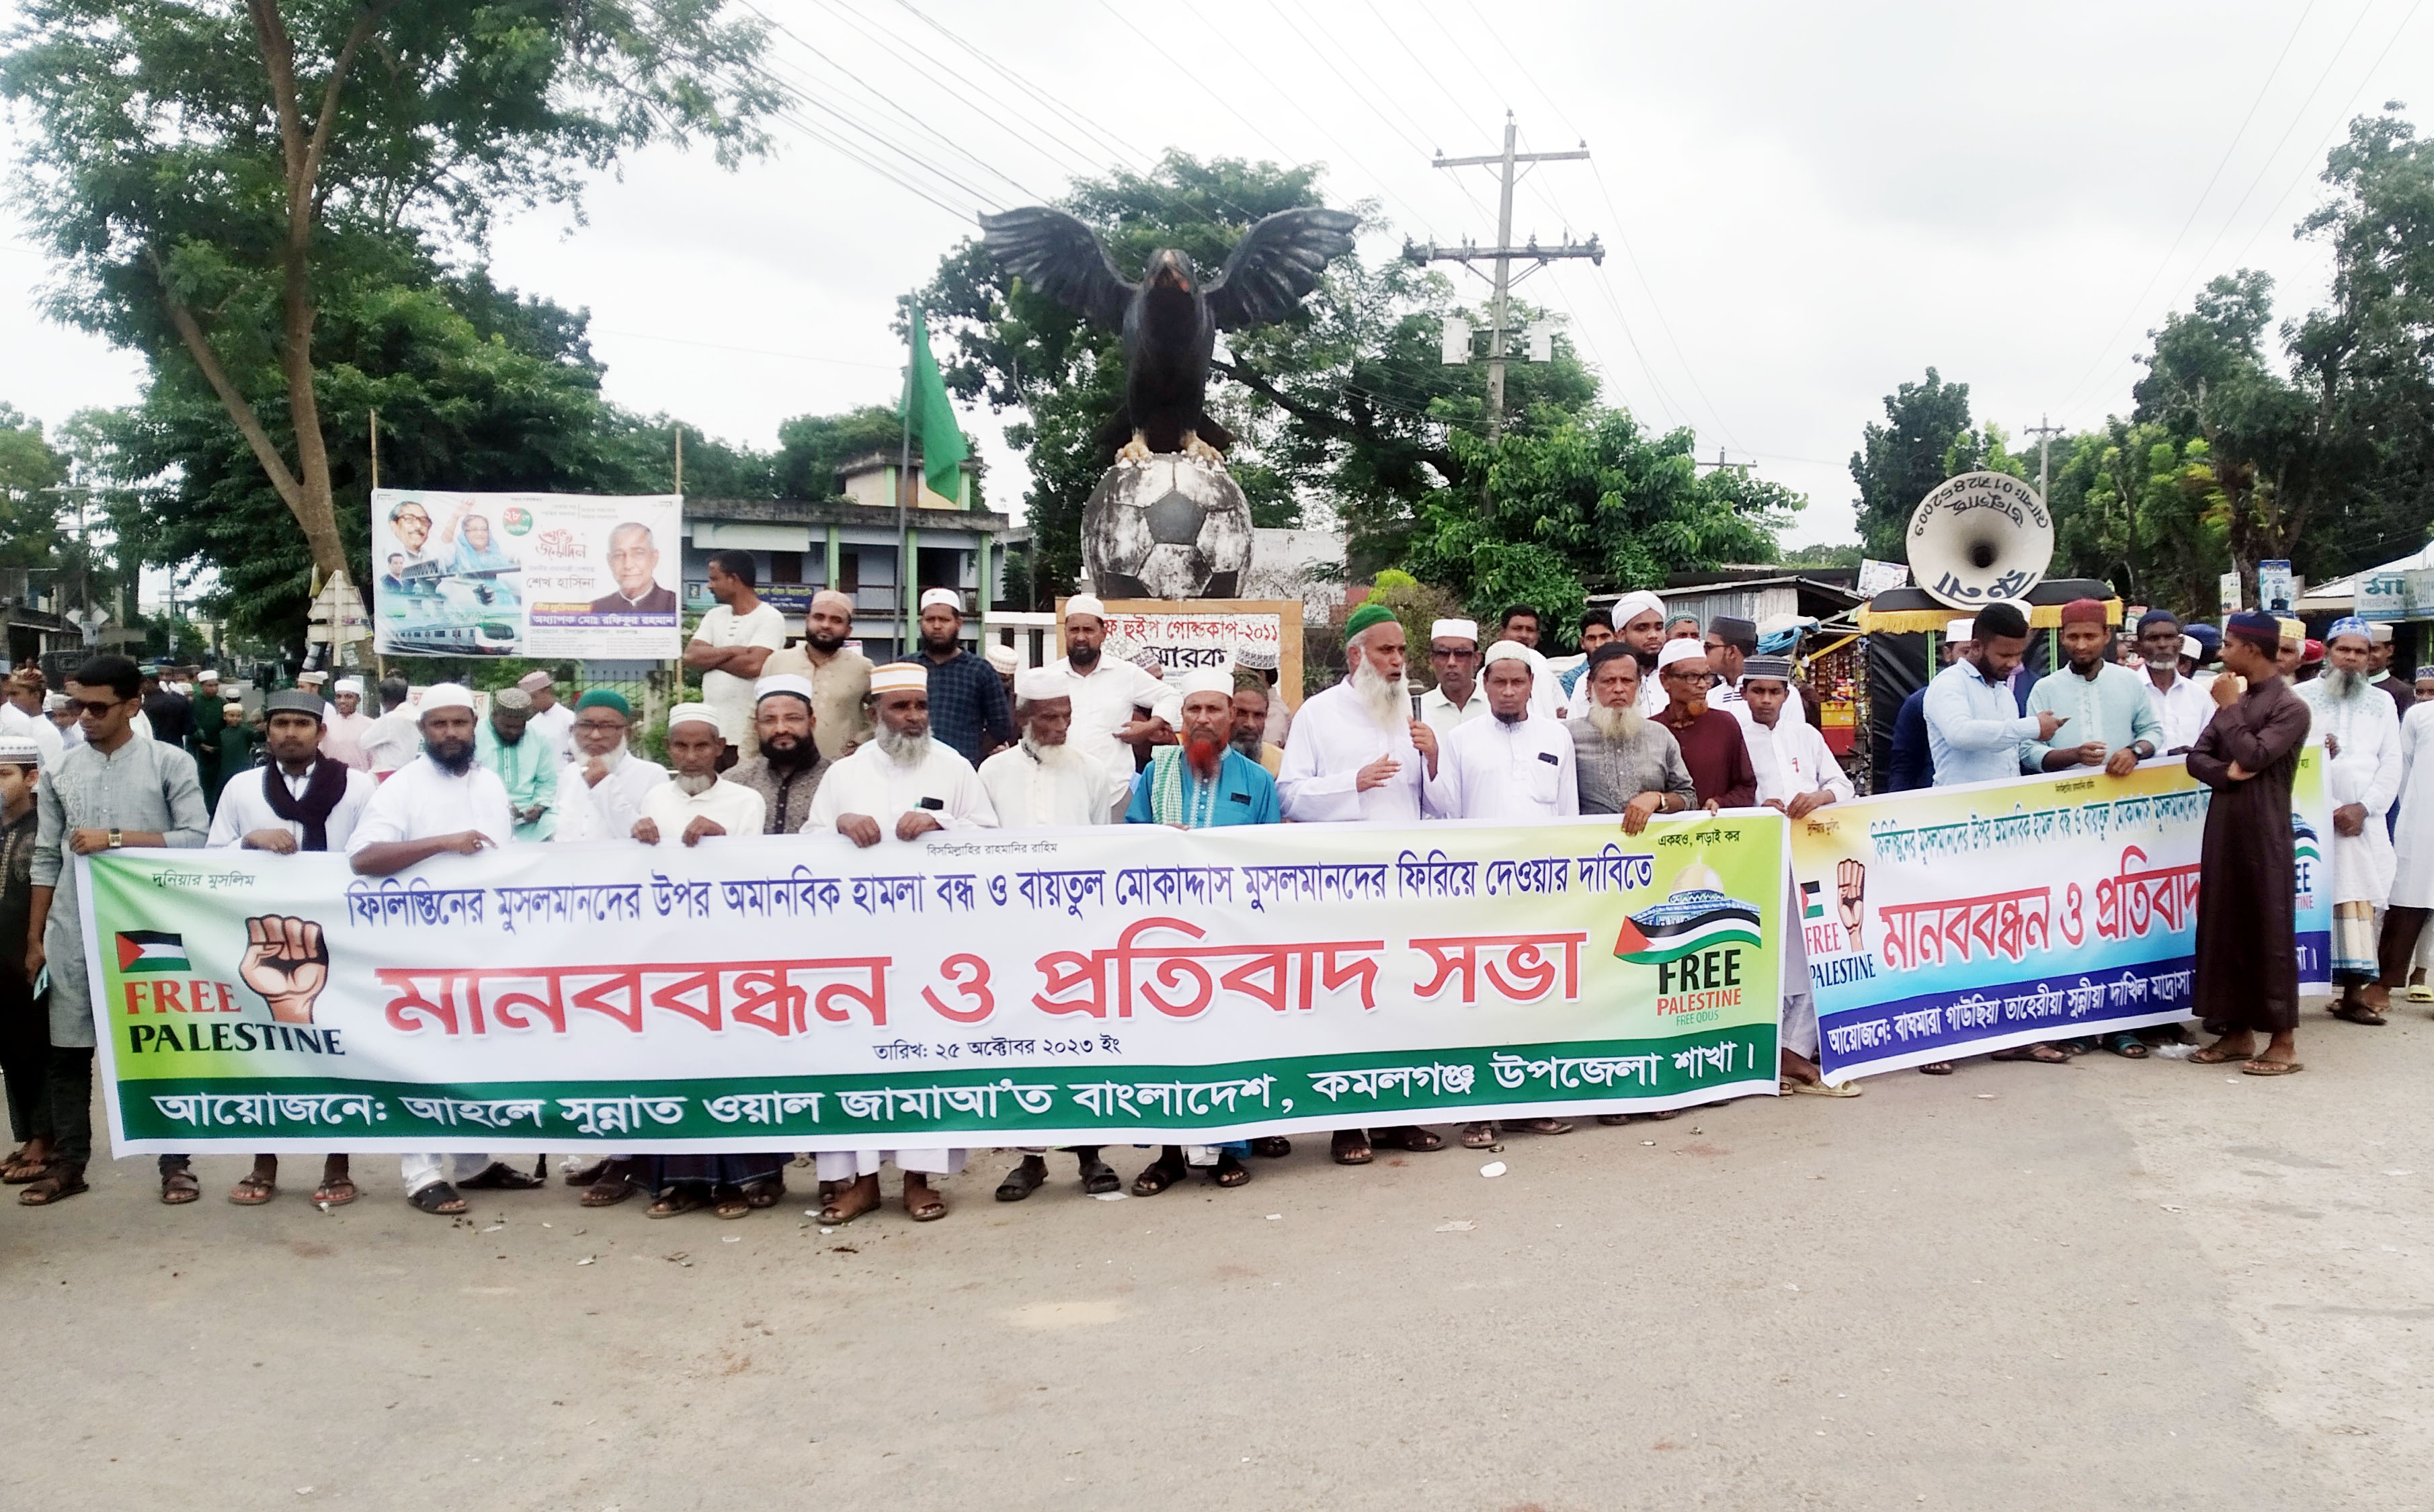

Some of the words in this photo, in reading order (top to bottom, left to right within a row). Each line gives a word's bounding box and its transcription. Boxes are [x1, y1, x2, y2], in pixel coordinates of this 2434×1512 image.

[526, 577, 551, 589] শেখ
[557, 573, 596, 589] হাসিনা
[1031, 841, 1058, 854] রাহিম
[1696, 829, 1722, 845] লড়াই
[1724, 830, 1741, 842] কর
[152, 869, 203, 888] দুনিয়ার
[208, 870, 256, 890] মুসলিম
[344, 876, 485, 927] ফিলিস্তিনের
[493, 882, 643, 935] মুসলমানদের
[649, 869, 712, 919] উপর
[719, 864, 840, 917] অমানবিক
[850, 871, 928, 915] হামলা
[934, 873, 977, 912] বন্ধ
[986, 876, 1008, 906] ও
[1016, 869, 1106, 920] বায়তুল
[1115, 863, 1235, 907] মোকাদ্দাস
[1242, 858, 1389, 911] মুসলমানদের
[1395, 849, 1479, 898] ফিরিয়ে
[1485, 855, 1571, 895] দেওয়ার
[1576, 843, 1656, 892] দাবিতে
[2296, 864, 2312, 892] EE
[1805, 923, 1841, 956] FREE
[1878, 886, 2051, 968] মানববন্ধন
[2060, 882, 2083, 947] ও
[374, 955, 893, 1038] মানববন্ধন
[922, 953, 995, 1025] ও
[1032, 917, 1385, 1019] প্রতিবাদ
[1410, 932, 1587, 1004] সভা
[1659, 949, 1741, 995] FREE
[1810, 954, 1876, 989] PALESTINE
[124, 980, 241, 1014] FREE
[1657, 988, 1742, 1016] PALESTINE
[1893, 1005, 1942, 1042] বাঘমারা
[2109, 971, 2149, 1007] দাখিল
[2151, 969, 2191, 1005] মাদ্রাসা
[1676, 1013, 1695, 1026] FREE
[1696, 1009, 1719, 1023] QDUS
[128, 1023, 346, 1056] PALESTINE
[935, 1043, 960, 1060] ২৫
[967, 1035, 1037, 1057] অক্টোবর
[1043, 1038, 1094, 1057] ২০২৩
[1100, 1032, 1123, 1055] ইং
[398, 1097, 546, 1130] আহলে
[559, 1095, 688, 1138] সুন্নাত
[704, 1089, 826, 1126] ওয়াল
[1307, 1060, 1476, 1101] কমলগঞ্জ
[1489, 1050, 1664, 1092] উপজেলা
